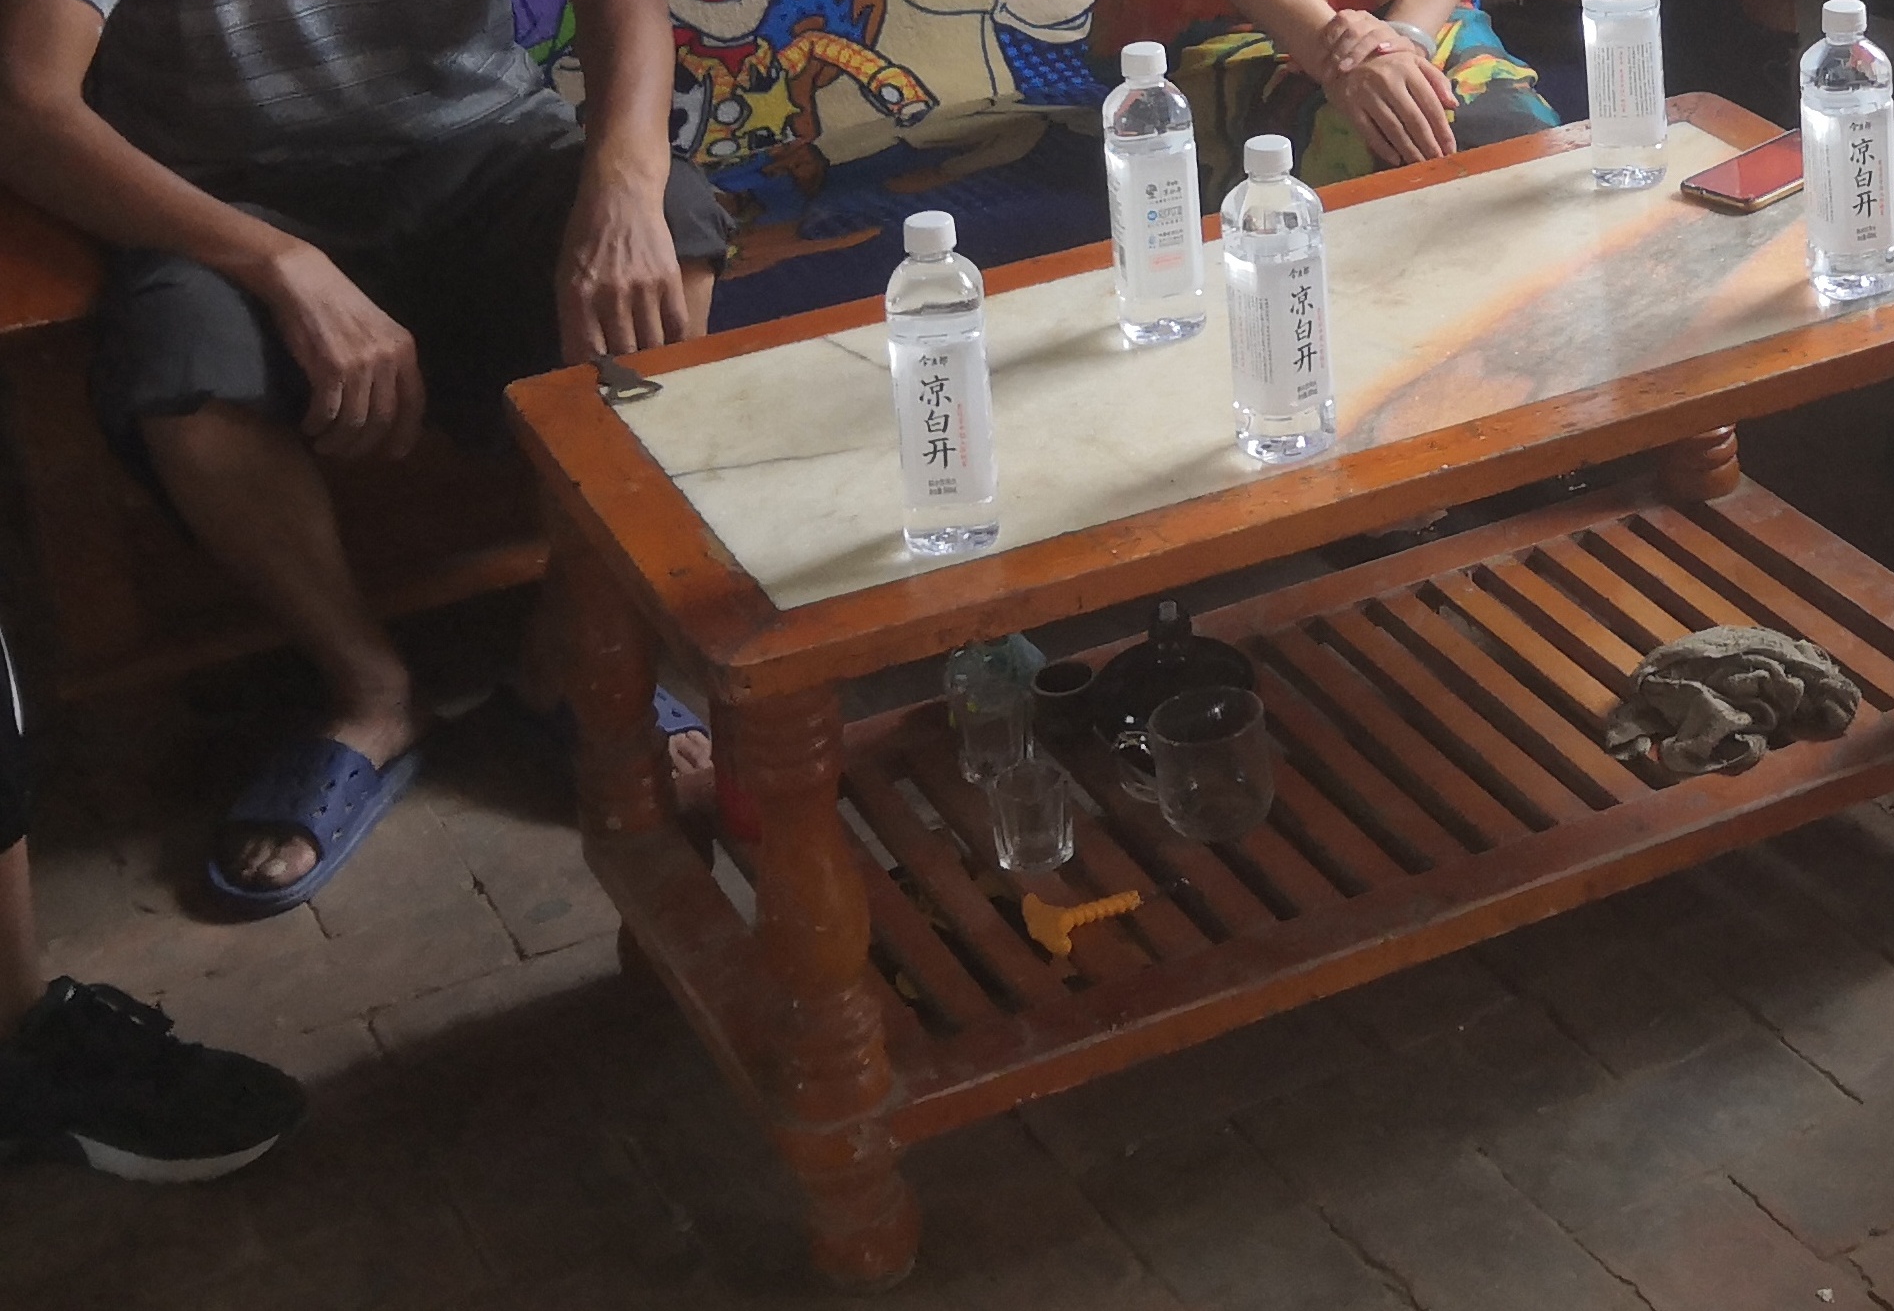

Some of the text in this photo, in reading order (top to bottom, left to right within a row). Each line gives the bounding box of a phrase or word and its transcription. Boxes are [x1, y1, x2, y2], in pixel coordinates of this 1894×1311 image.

[1850, 138, 1877, 218] 凉白开
[1290, 285, 1317, 372] 凉白开
[919, 375, 956, 469] 凉白开
